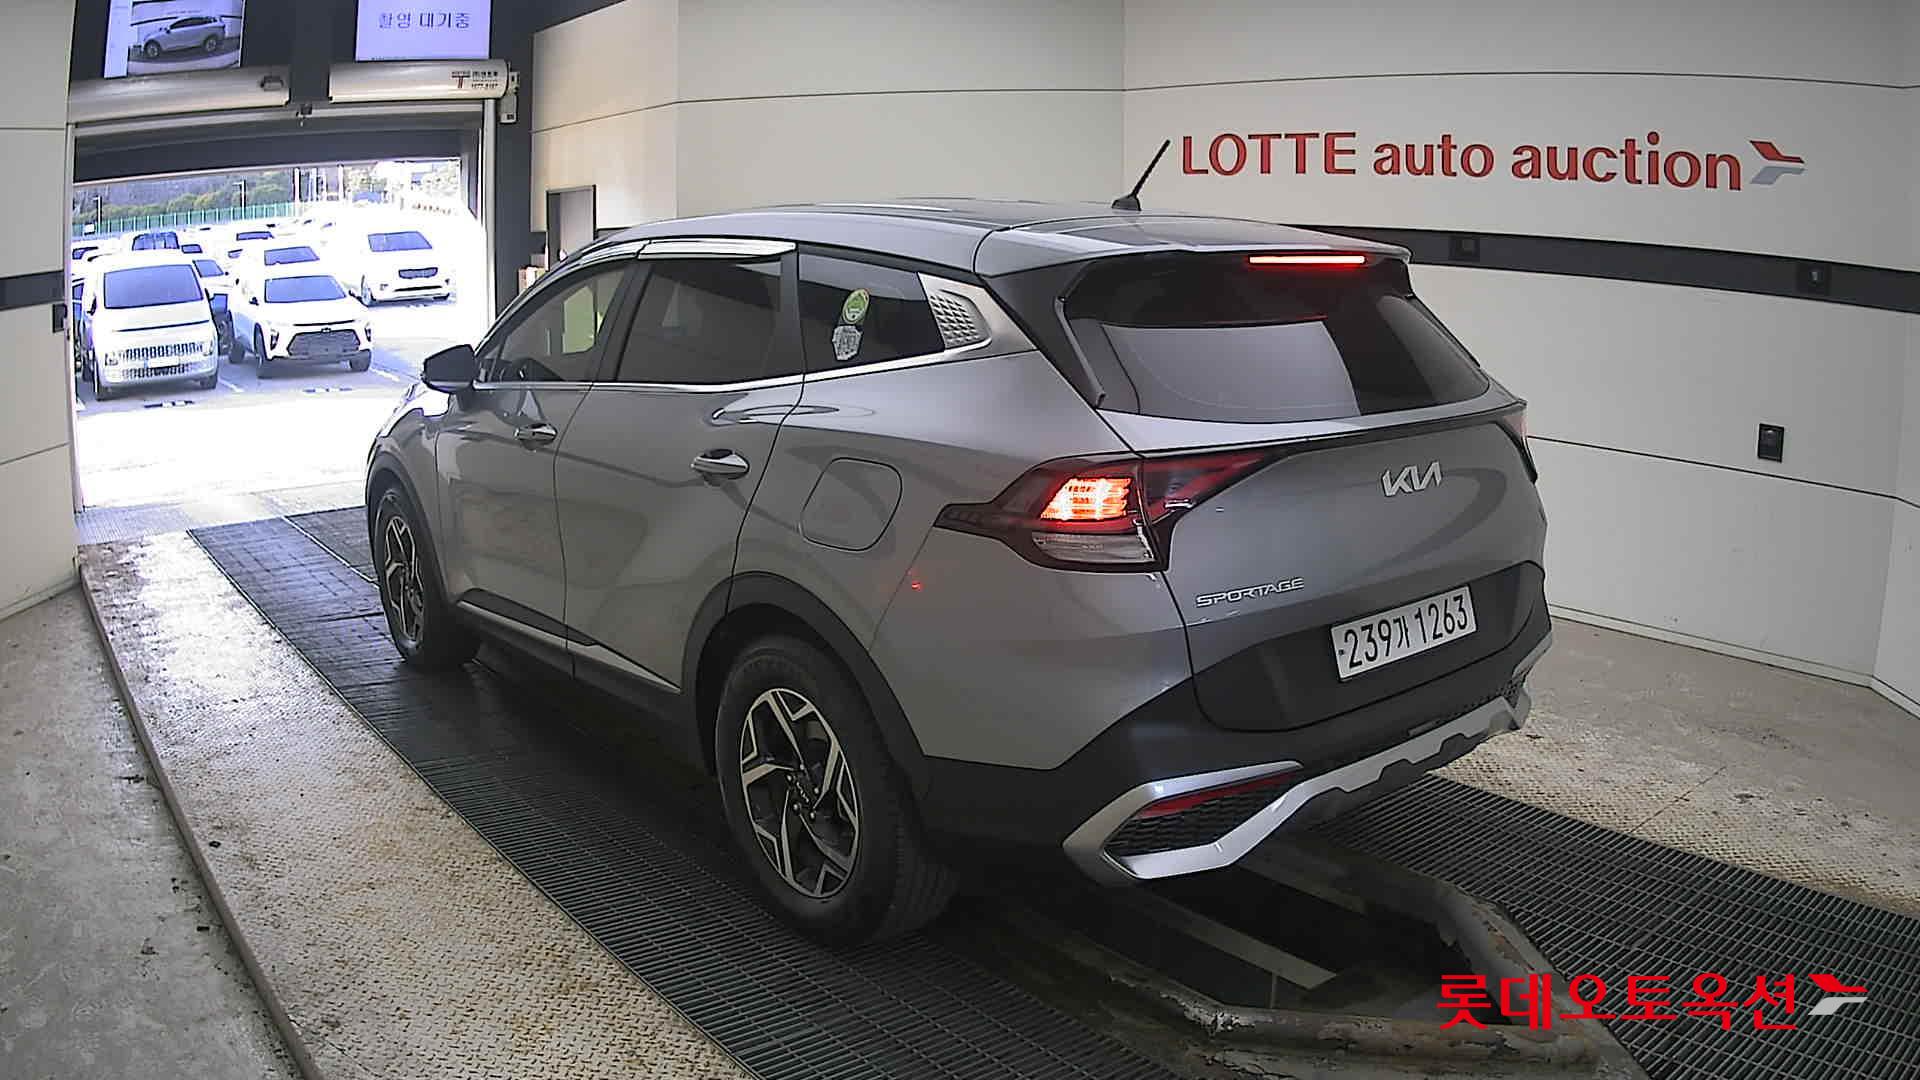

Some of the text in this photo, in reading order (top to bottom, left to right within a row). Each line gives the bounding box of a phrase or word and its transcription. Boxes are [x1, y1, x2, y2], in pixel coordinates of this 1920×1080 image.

[419, 13, 470, 29] 대기중
[1182, 131, 1742, 191] LOTTE auto auction
[1195, 576, 1305, 609] SPORTAGE
[1414, 594, 1469, 644] 1263
